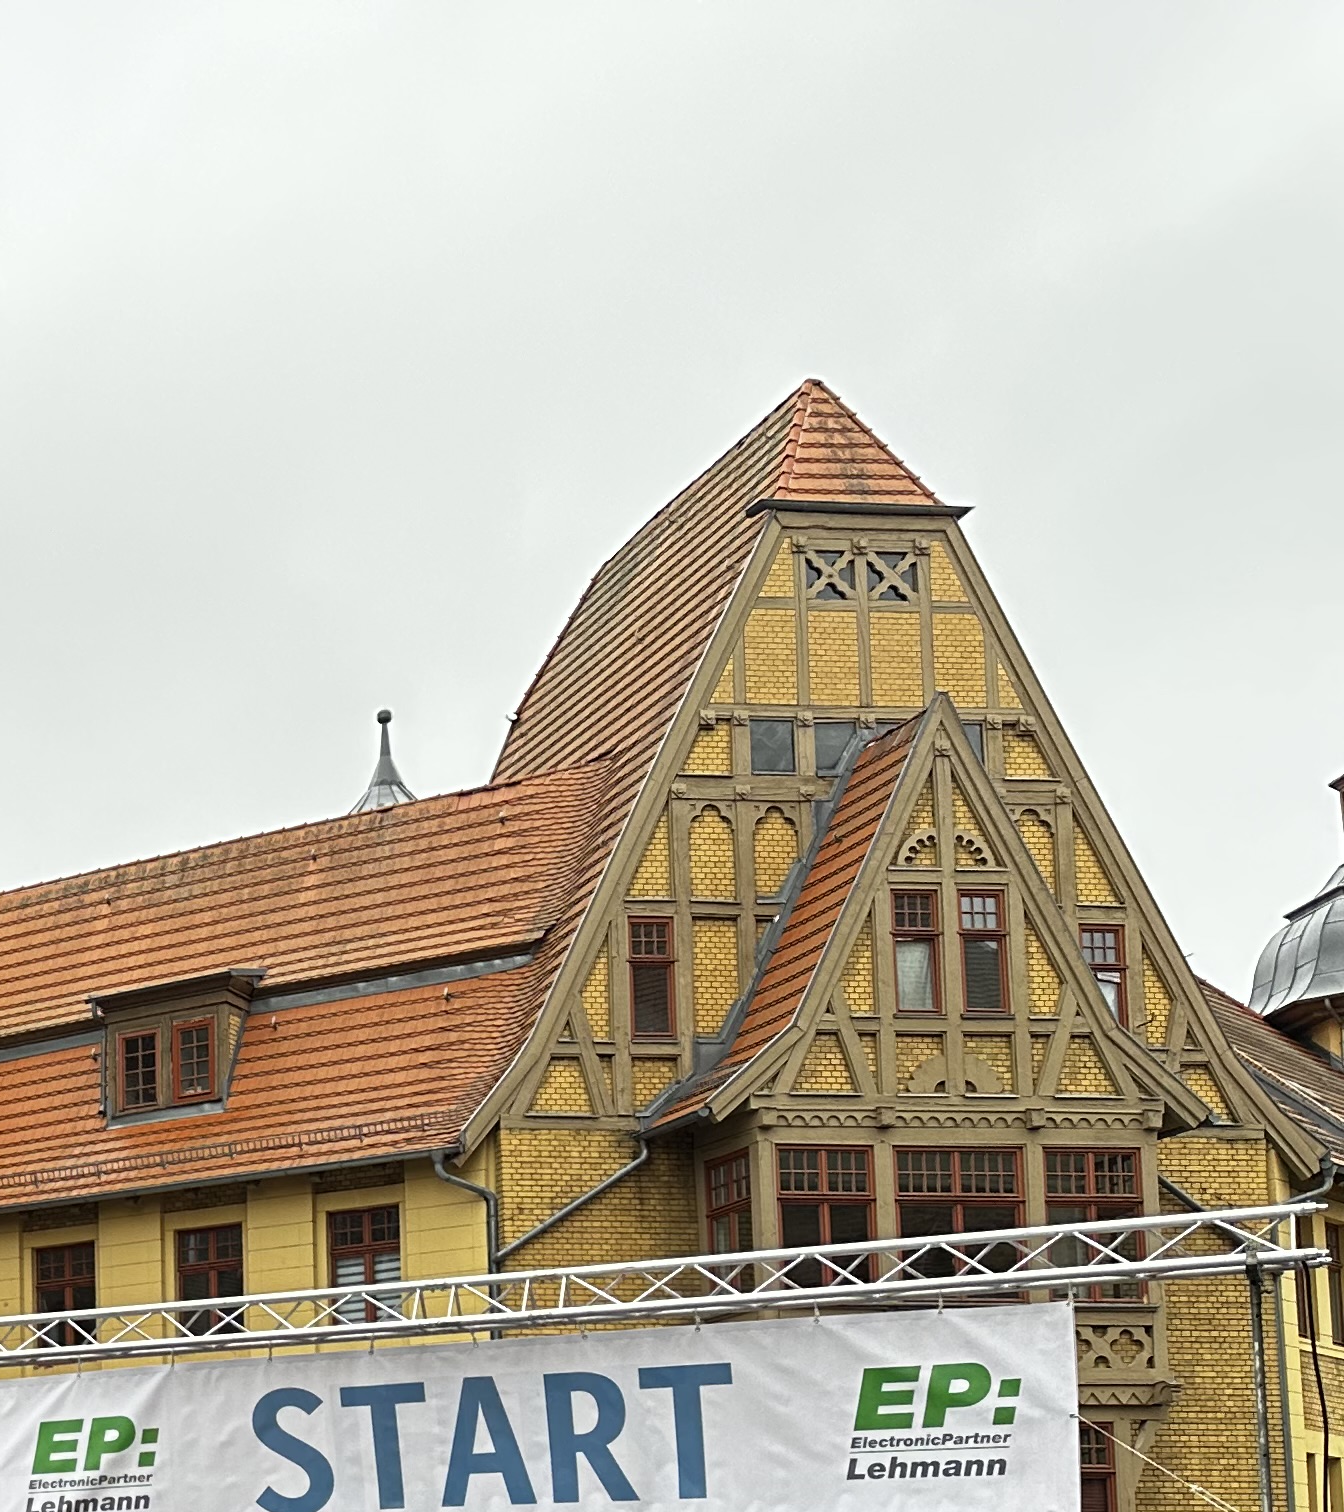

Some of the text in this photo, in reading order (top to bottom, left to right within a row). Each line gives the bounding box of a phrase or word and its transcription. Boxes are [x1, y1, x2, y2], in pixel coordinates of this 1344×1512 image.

[853, 1362, 1022, 1432] EP:
[31, 1415, 160, 1475] EP:
[850, 1432, 1012, 1449] ElectronicPartner
[28, 1472, 153, 1490] ElectronicPartner
[846, 1456, 1007, 1481] Lehmann
